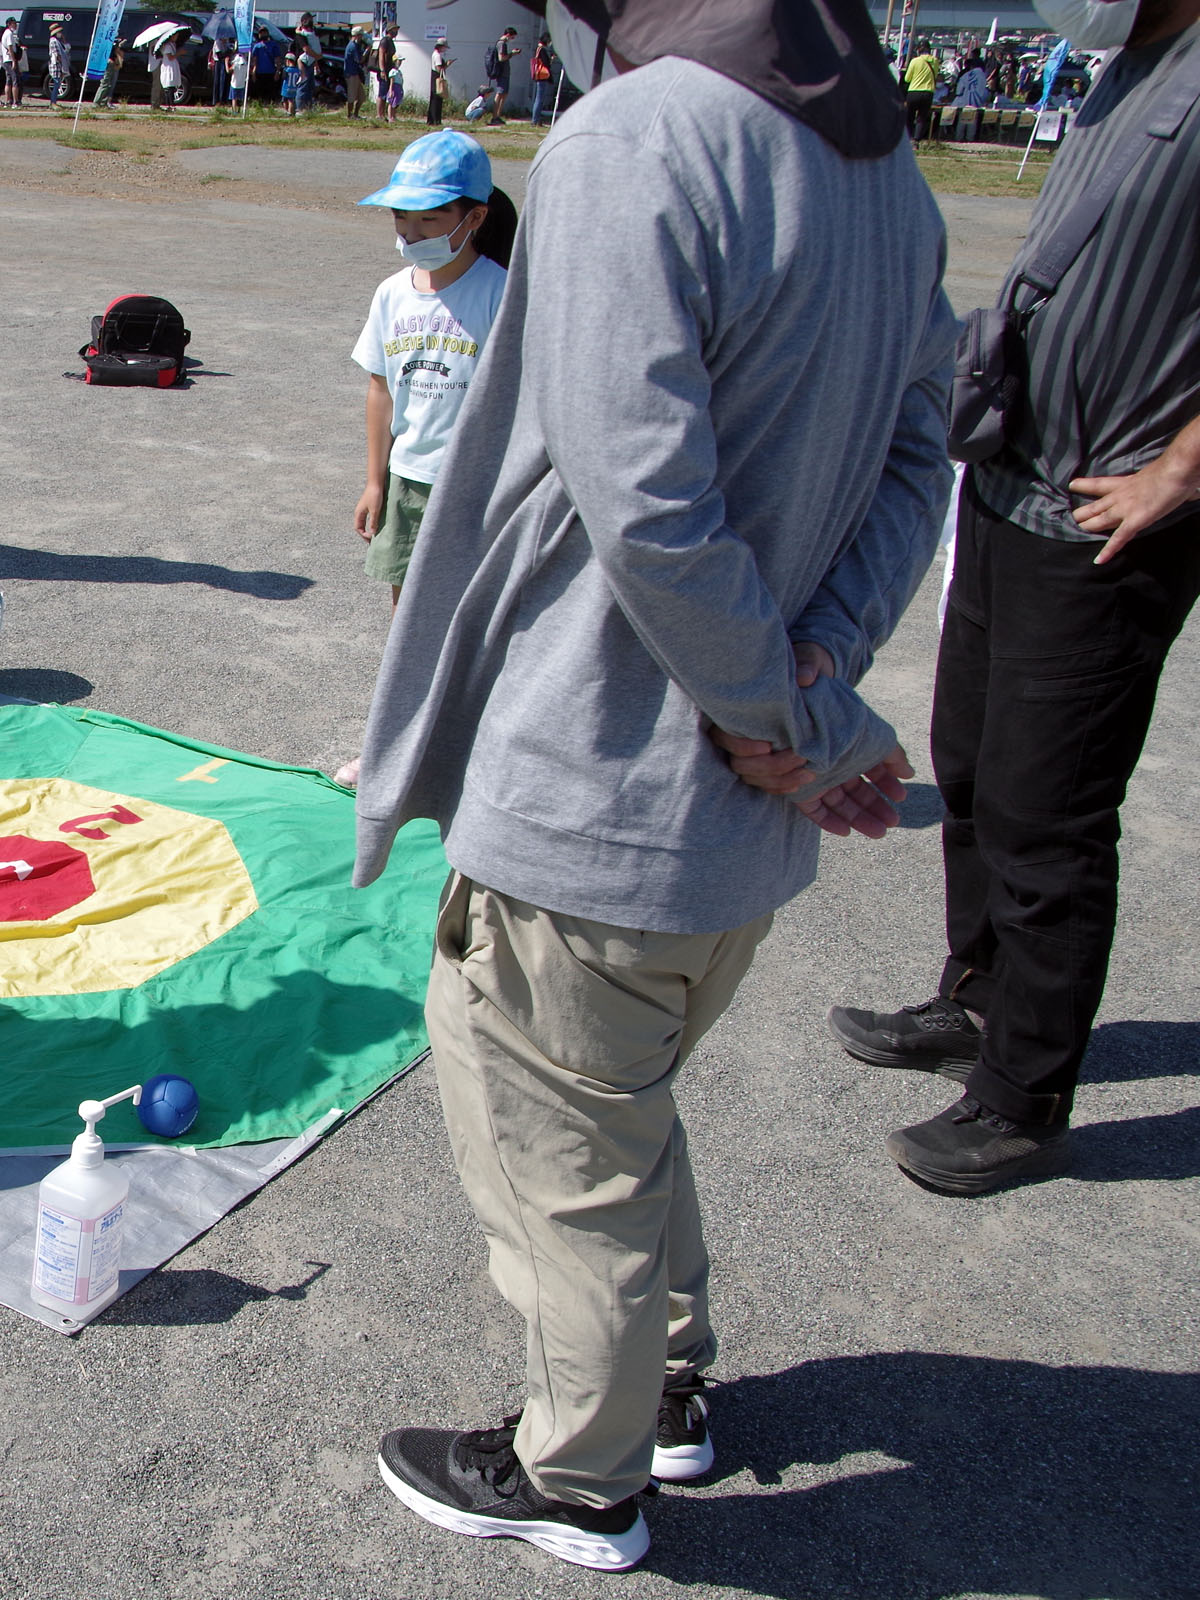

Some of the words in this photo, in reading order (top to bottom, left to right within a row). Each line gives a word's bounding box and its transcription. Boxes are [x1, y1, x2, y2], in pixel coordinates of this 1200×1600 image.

[394, 315, 426, 337] ALGY
[430, 315, 462, 337] GIRL
[426, 335, 440, 350] IN
[442, 336, 479, 358] YOUR
[405, 361, 422, 371] LOVE
[422, 361, 444, 371] POWER
[419, 381, 439, 390] WHEN
[440, 382, 468, 390] YOU'RE
[428, 391, 443, 400] FUN
